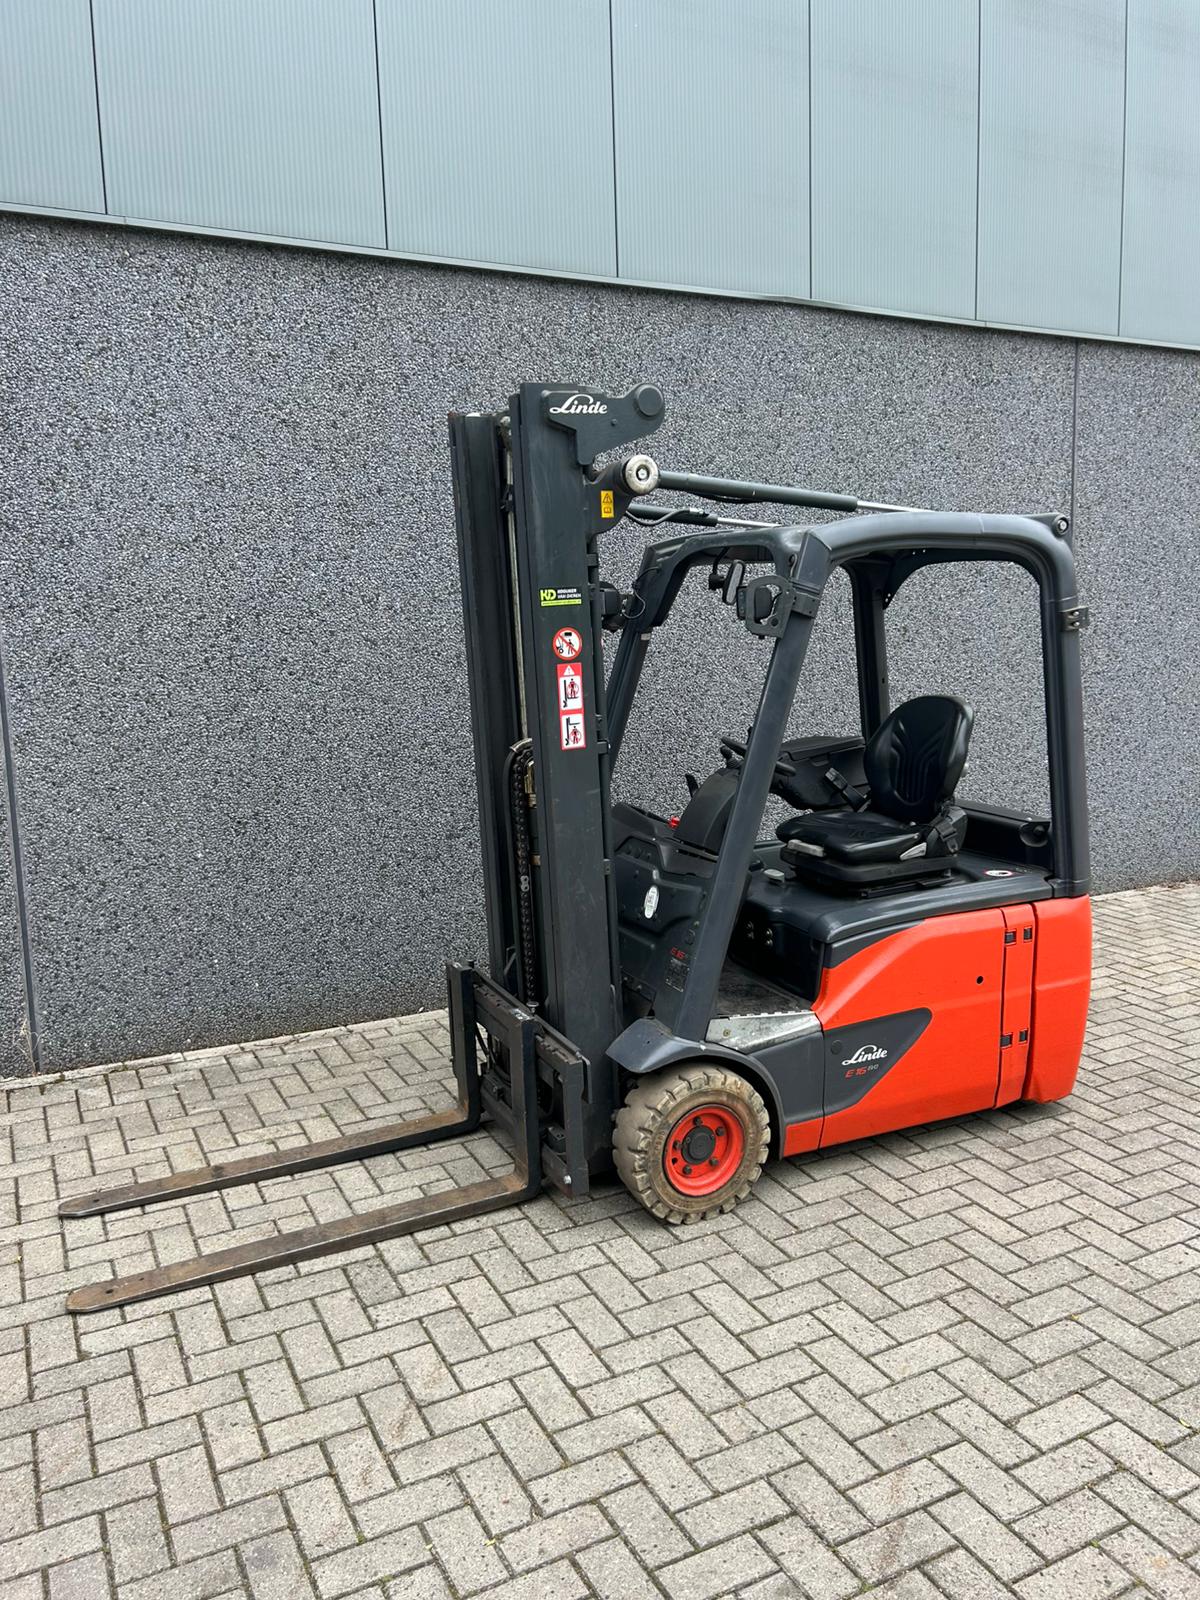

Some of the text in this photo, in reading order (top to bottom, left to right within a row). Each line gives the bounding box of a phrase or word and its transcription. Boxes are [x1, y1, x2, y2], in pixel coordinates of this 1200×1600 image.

[549, 393, 608, 414] Linde
[540, 589, 557, 601] KD
[841, 1044, 888, 1066] Linde
